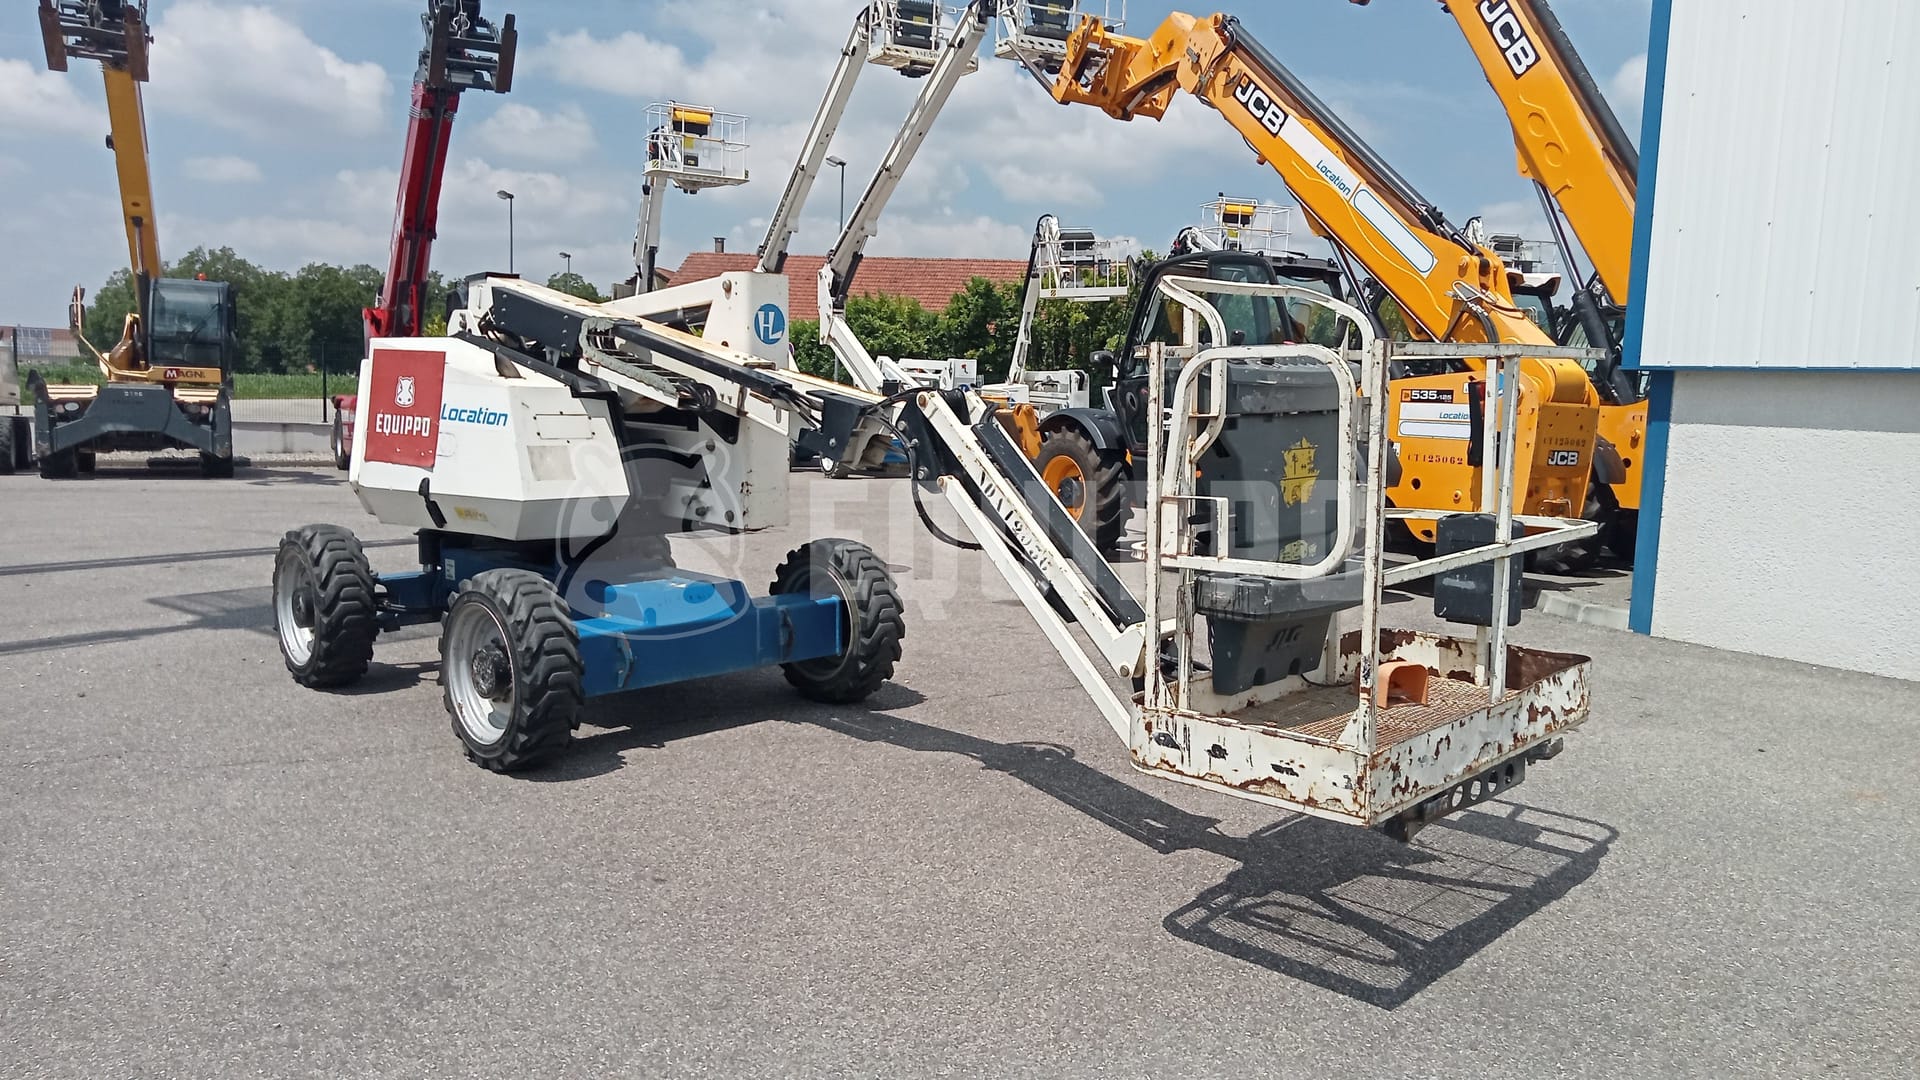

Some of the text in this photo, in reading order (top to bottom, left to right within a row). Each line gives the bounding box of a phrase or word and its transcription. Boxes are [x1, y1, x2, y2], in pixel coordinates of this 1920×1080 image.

[1480, 0, 1536, 75] JCB
[1235, 82, 1285, 135] JCB
[1315, 159, 1352, 196] Location
[375, 412, 431, 437] EQUIPPO
[440, 403, 508, 427] Location
[1439, 411, 1469, 420] Locatio
[1548, 451, 1578, 465] JCB
